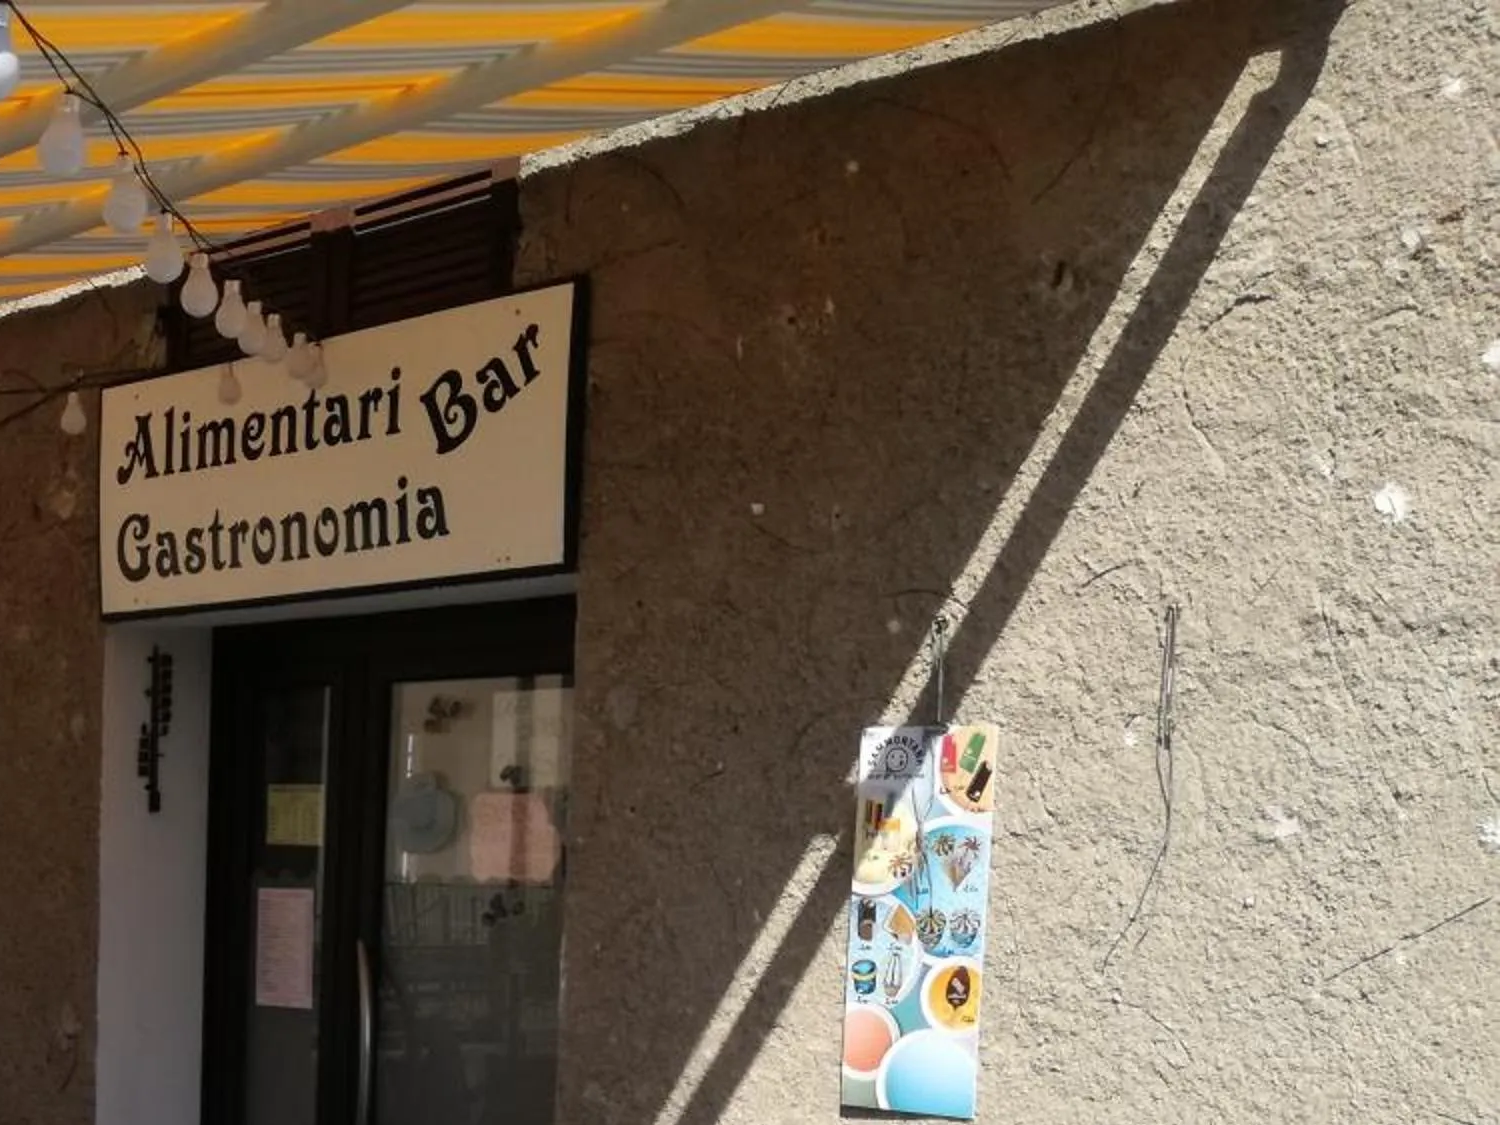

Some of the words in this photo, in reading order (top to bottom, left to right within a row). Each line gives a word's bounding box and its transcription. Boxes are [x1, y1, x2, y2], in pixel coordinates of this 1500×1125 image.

[116, 367, 402, 484] Alimentari
[419, 323, 541, 455] Bar
[117, 476, 450, 582] Gastronomia
